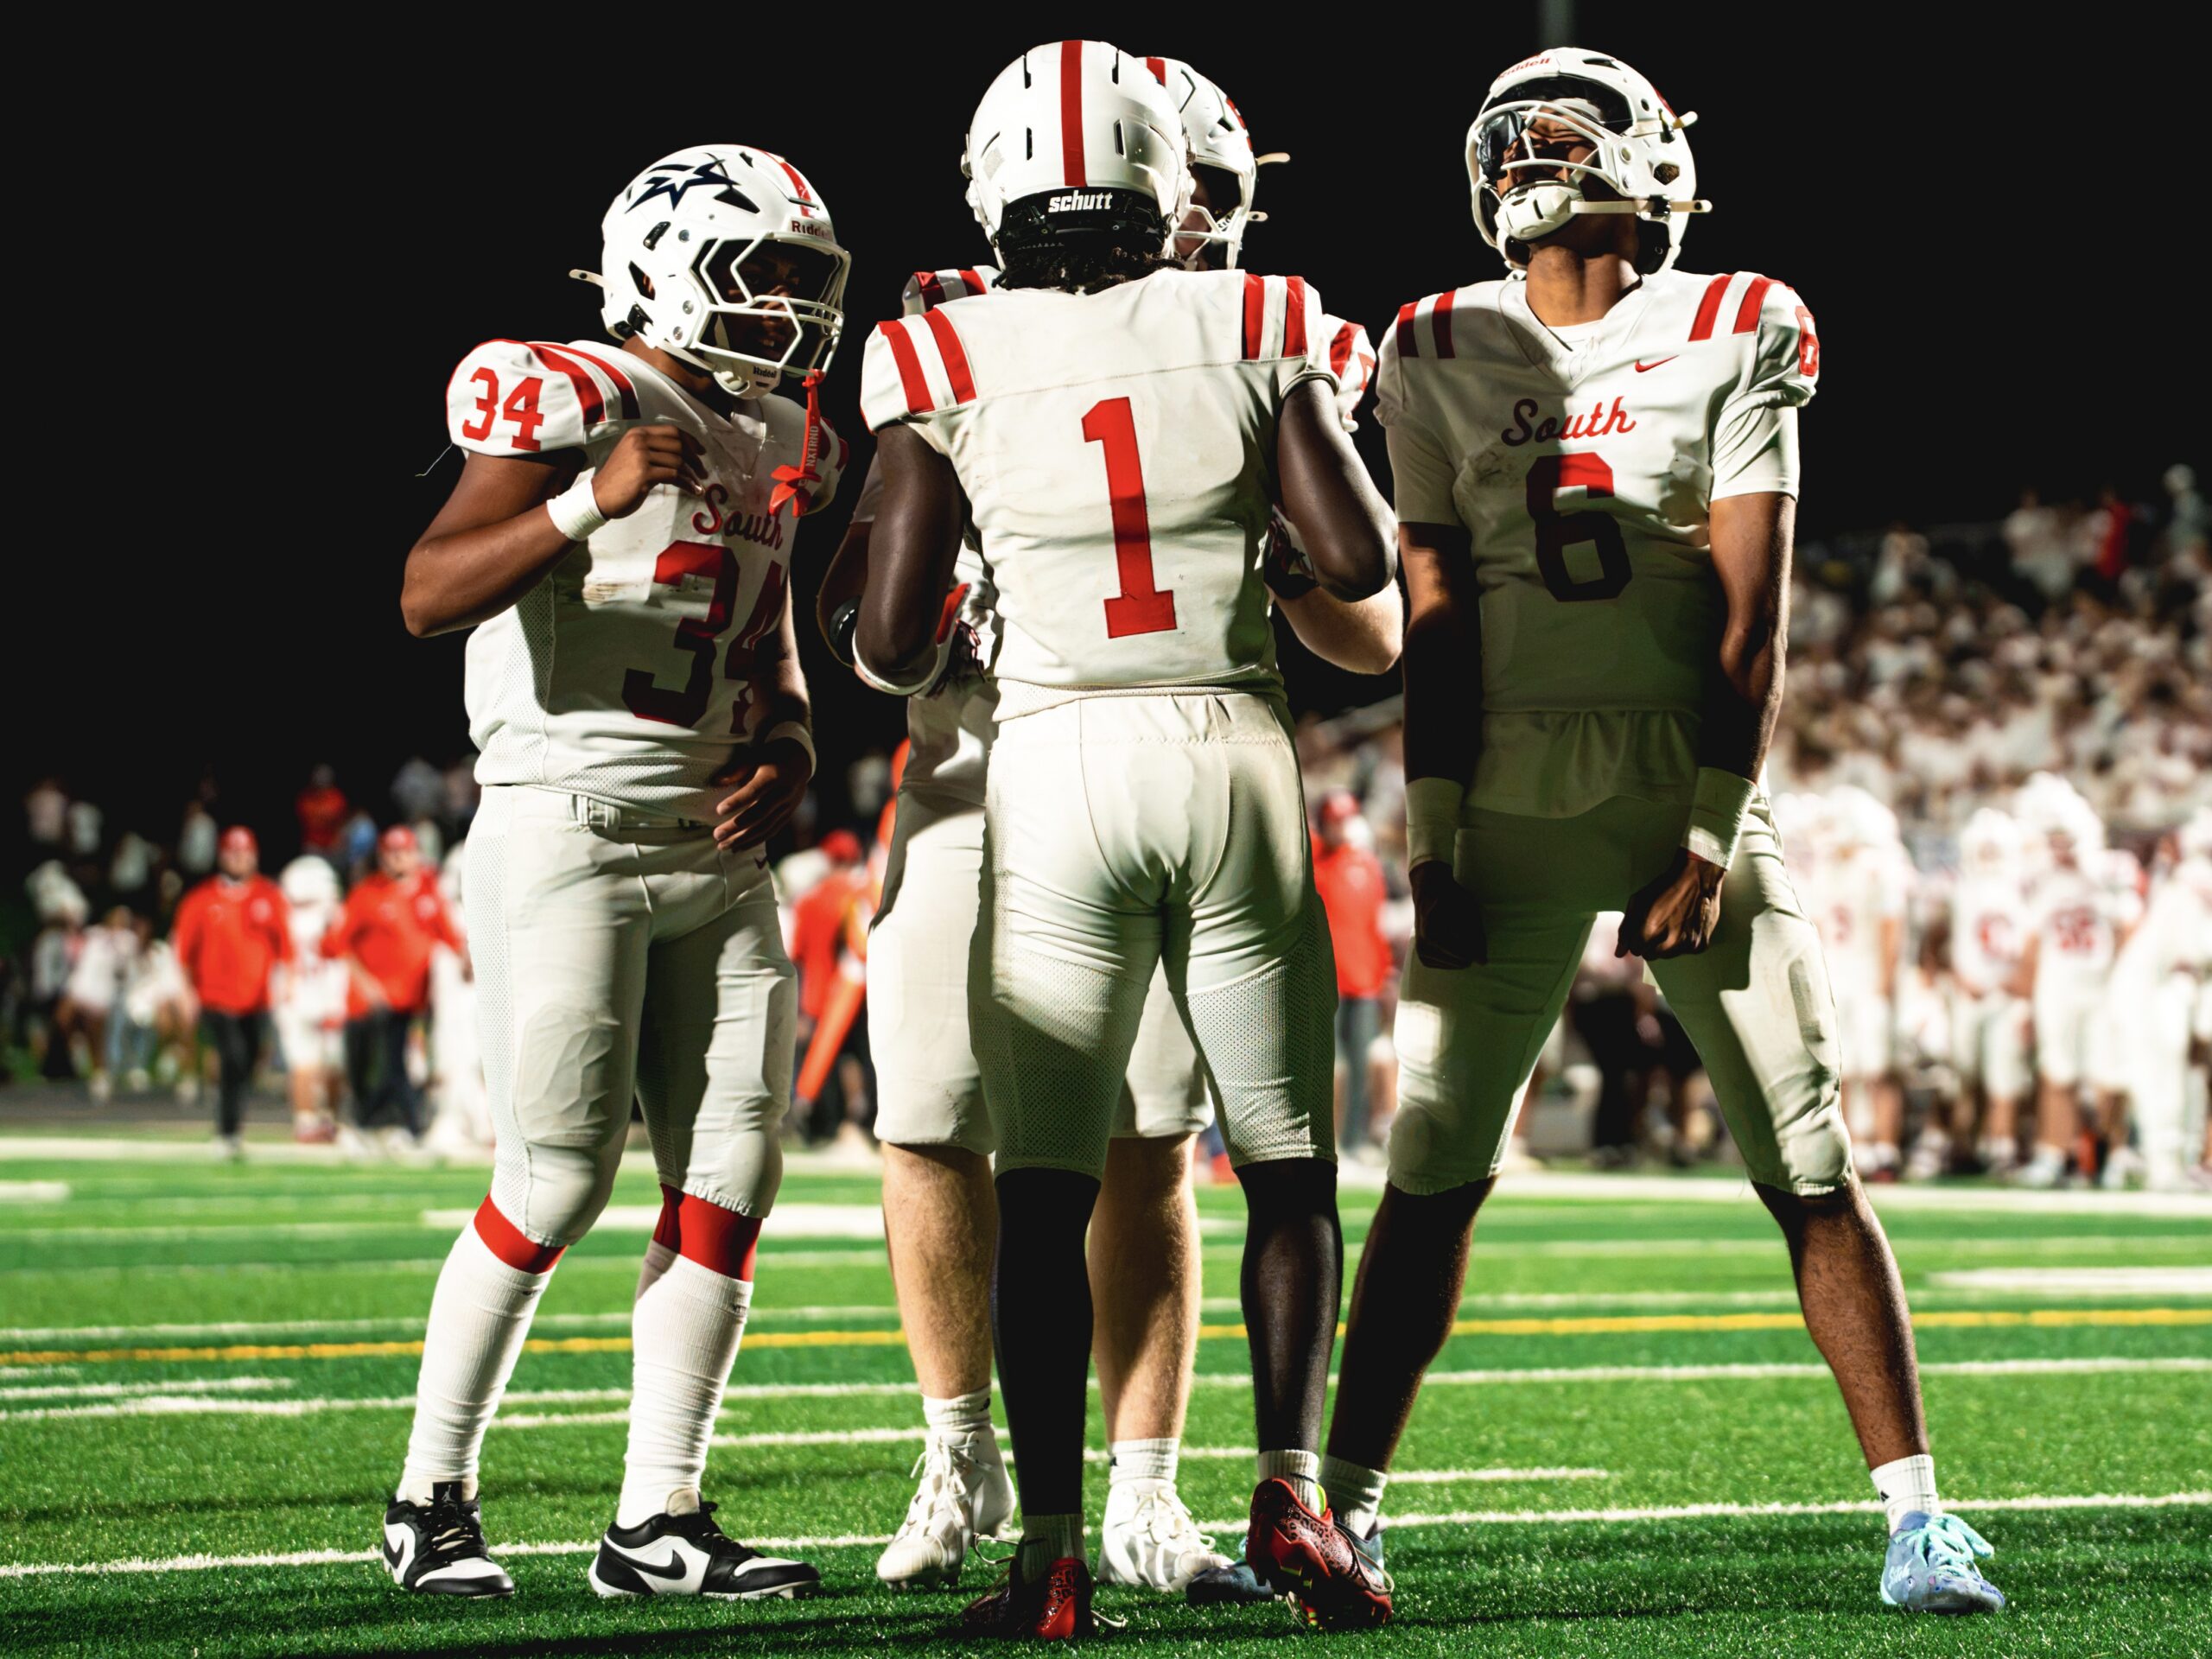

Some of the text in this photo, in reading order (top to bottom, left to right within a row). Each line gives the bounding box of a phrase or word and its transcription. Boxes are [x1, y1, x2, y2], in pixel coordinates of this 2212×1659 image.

[791, 219, 833, 241] Ridd
[1047, 189, 1113, 213] schutt
[461, 366, 544, 452] 34
[1502, 396, 1637, 447] South
[805, 424, 819, 467] NXTRND
[692, 483, 783, 550] South
[1081, 396, 1177, 639] 1
[1526, 452, 1632, 601] 6
